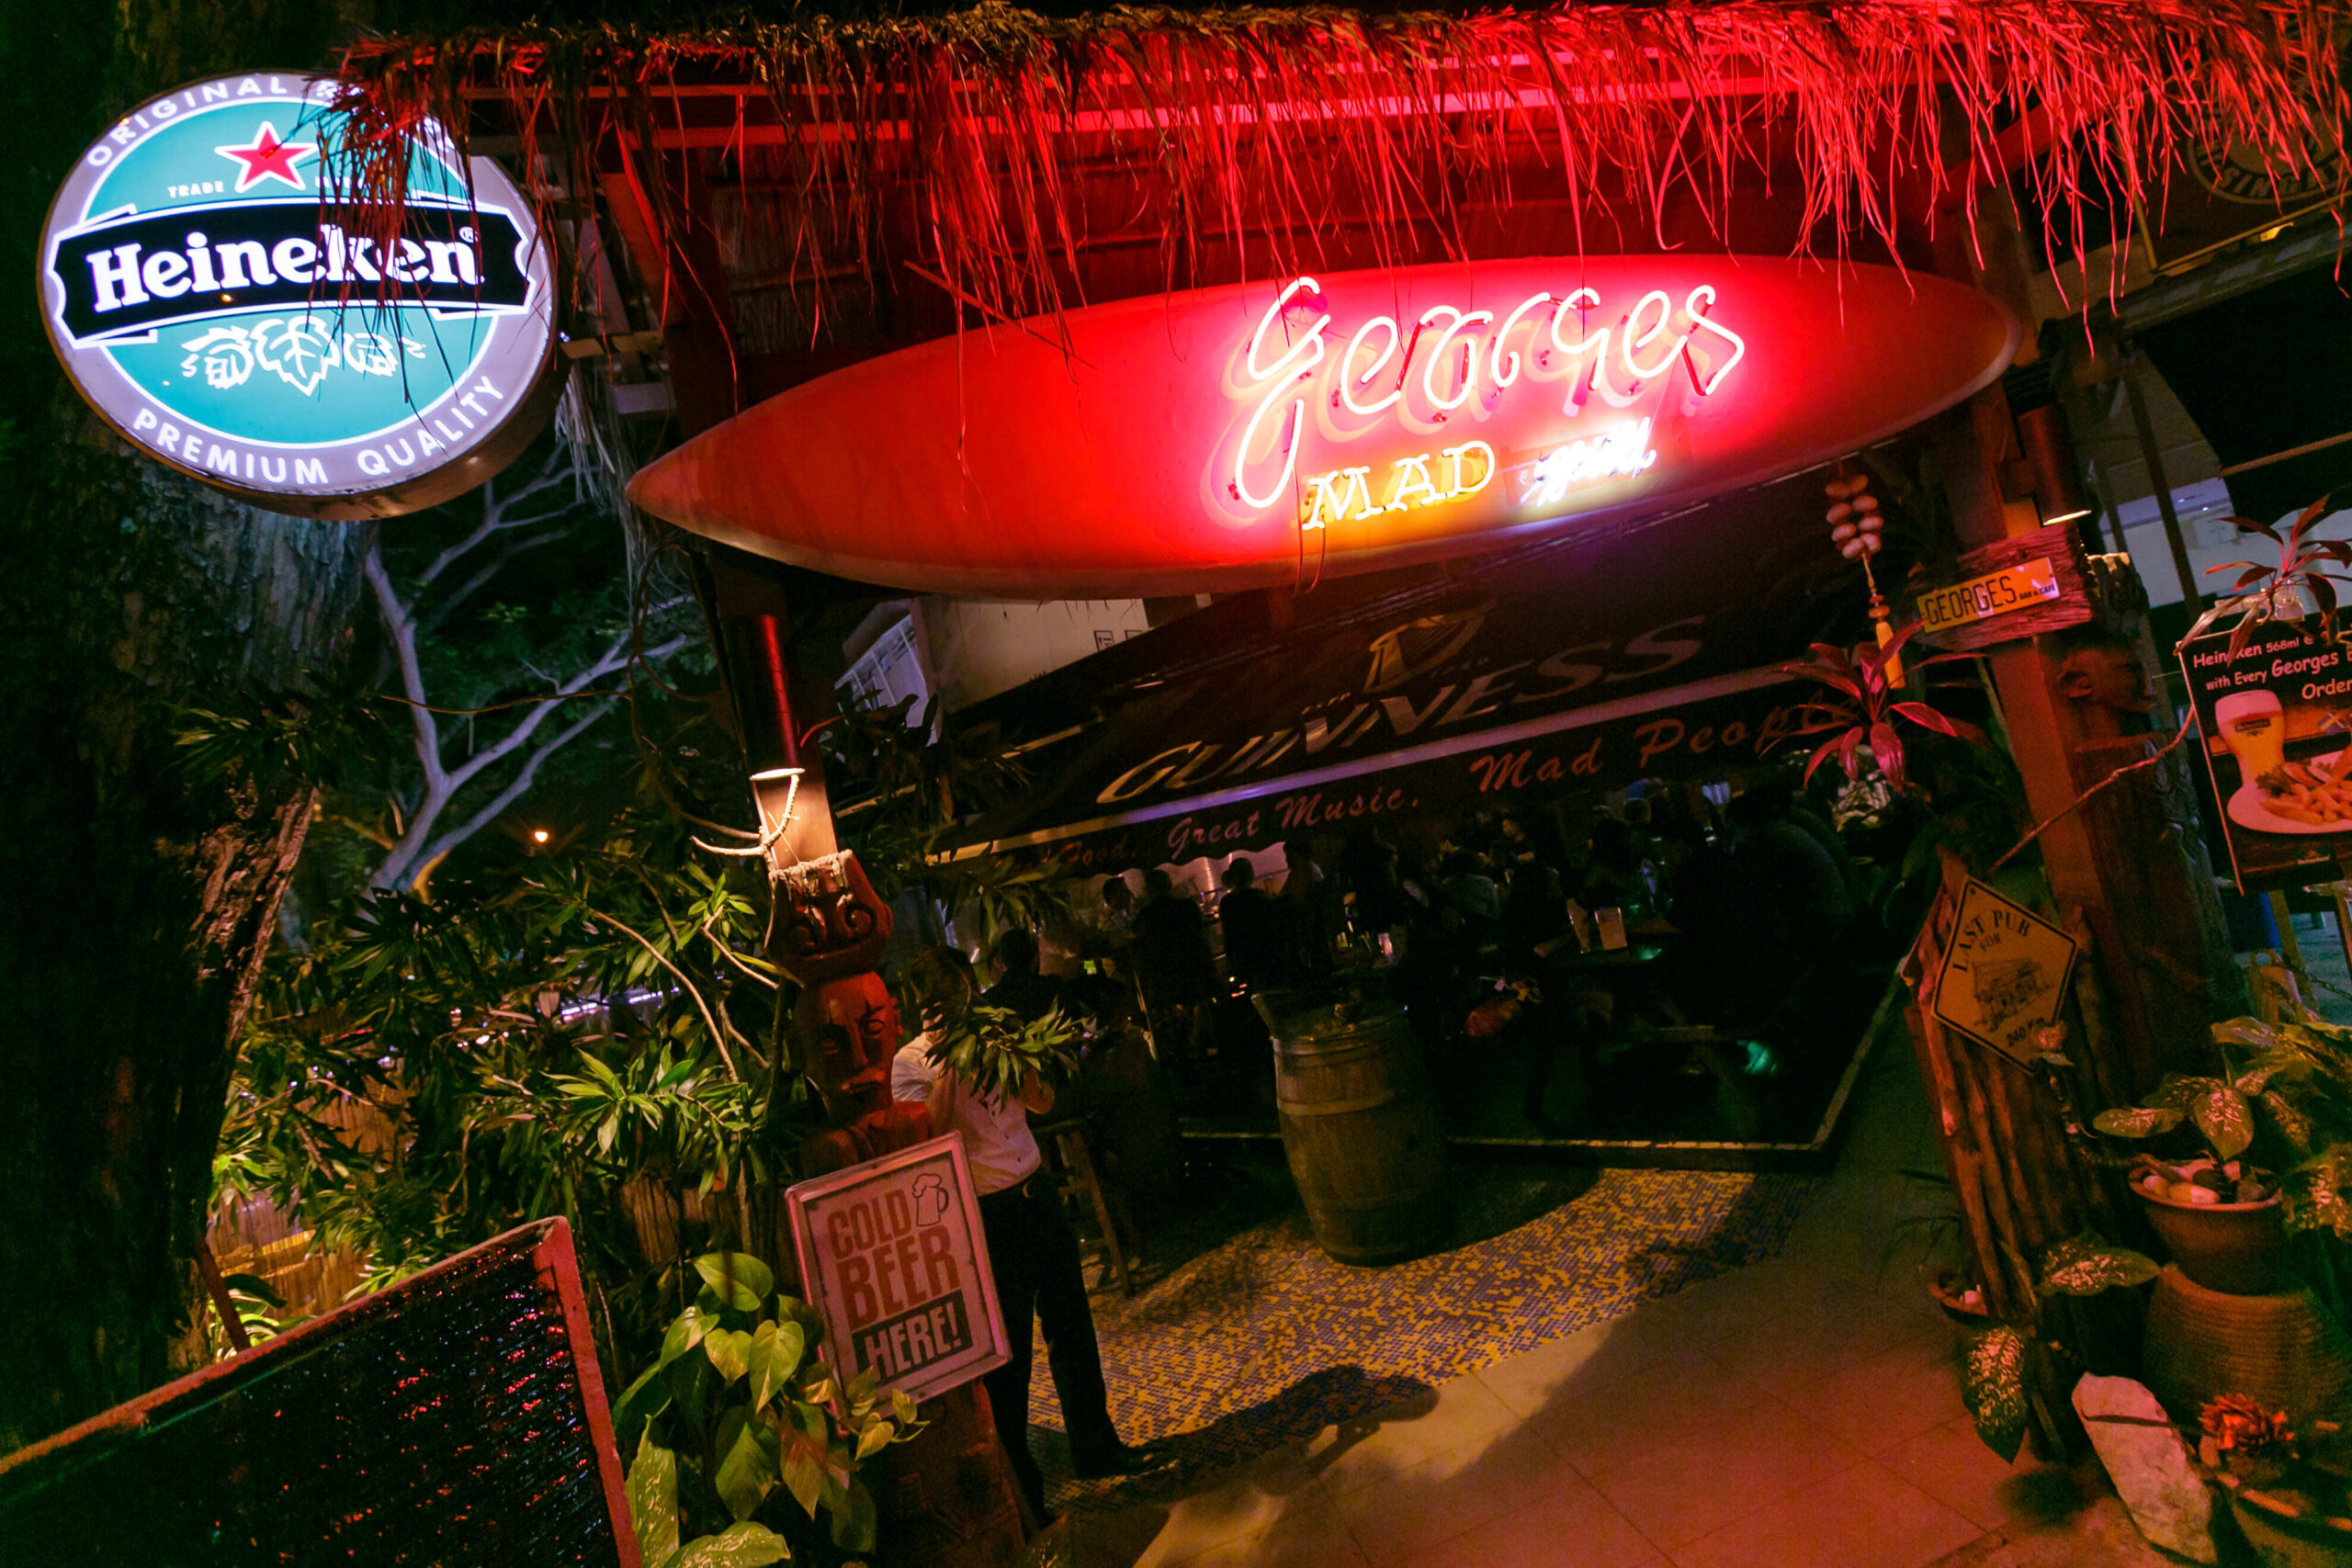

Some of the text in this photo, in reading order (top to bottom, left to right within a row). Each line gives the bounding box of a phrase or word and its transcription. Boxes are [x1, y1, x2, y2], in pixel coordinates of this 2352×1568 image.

[87, 77, 288, 168] ORIGINAL
[168, 180, 225, 198] TRADE
[86, 223, 485, 313] Heineken
[134, 407, 329, 484] PREMIUM
[356, 375, 504, 477] QUALITY
[1300, 440, 1496, 531] MAD
[1924, 575, 2017, 626] GEORGES
[2205, 674, 2232, 691] with
[2234, 670, 2267, 684] Every
[2271, 651, 2339, 678] Georges
[2266, 636, 2300, 653] 568ml
[1095, 615, 1707, 804] GUINNESS
[1167, 810, 1260, 862] Great
[1275, 787, 1419, 829] Music.
[1469, 737, 1603, 794] Mad
[1952, 910, 2030, 972] LAST PUB
[827, 1189, 912, 1259] COLD
[836, 1224, 961, 1330] BEER
[865, 1301, 962, 1379] HERE!
